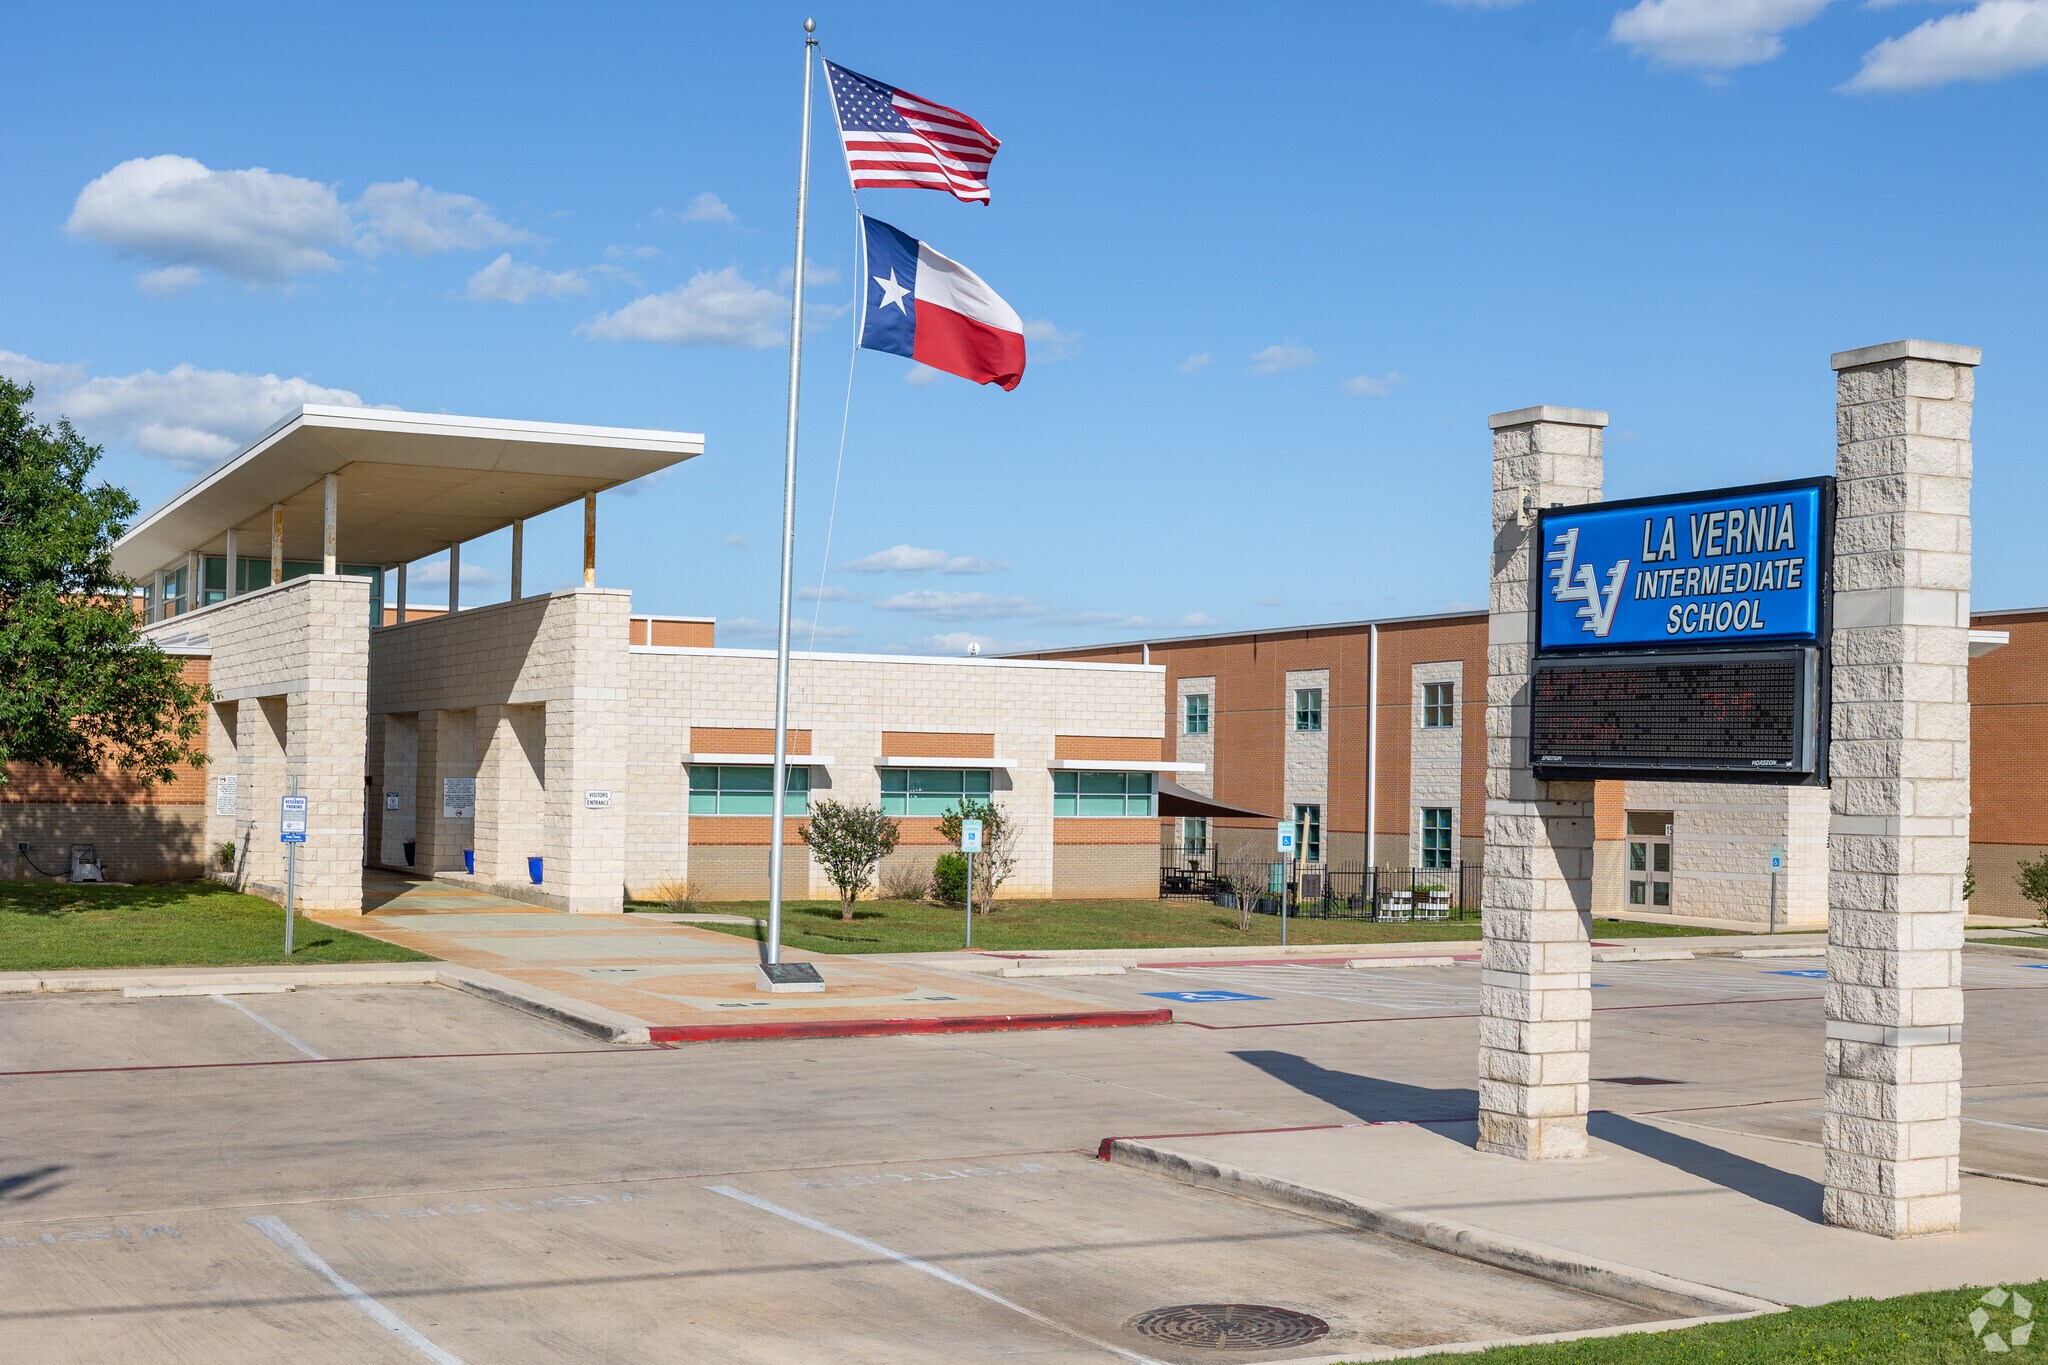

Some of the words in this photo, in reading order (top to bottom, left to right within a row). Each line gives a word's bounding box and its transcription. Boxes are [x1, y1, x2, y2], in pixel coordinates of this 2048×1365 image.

[1641, 516, 1677, 563] LA
[1690, 502, 1796, 559] VERNIA
[1634, 556, 1805, 601] INTERMEDIATE
[1666, 599, 1765, 635] SCHOOL
[586, 799, 610, 807] ENTRANCE
[1666, 825, 1674, 835] 15
